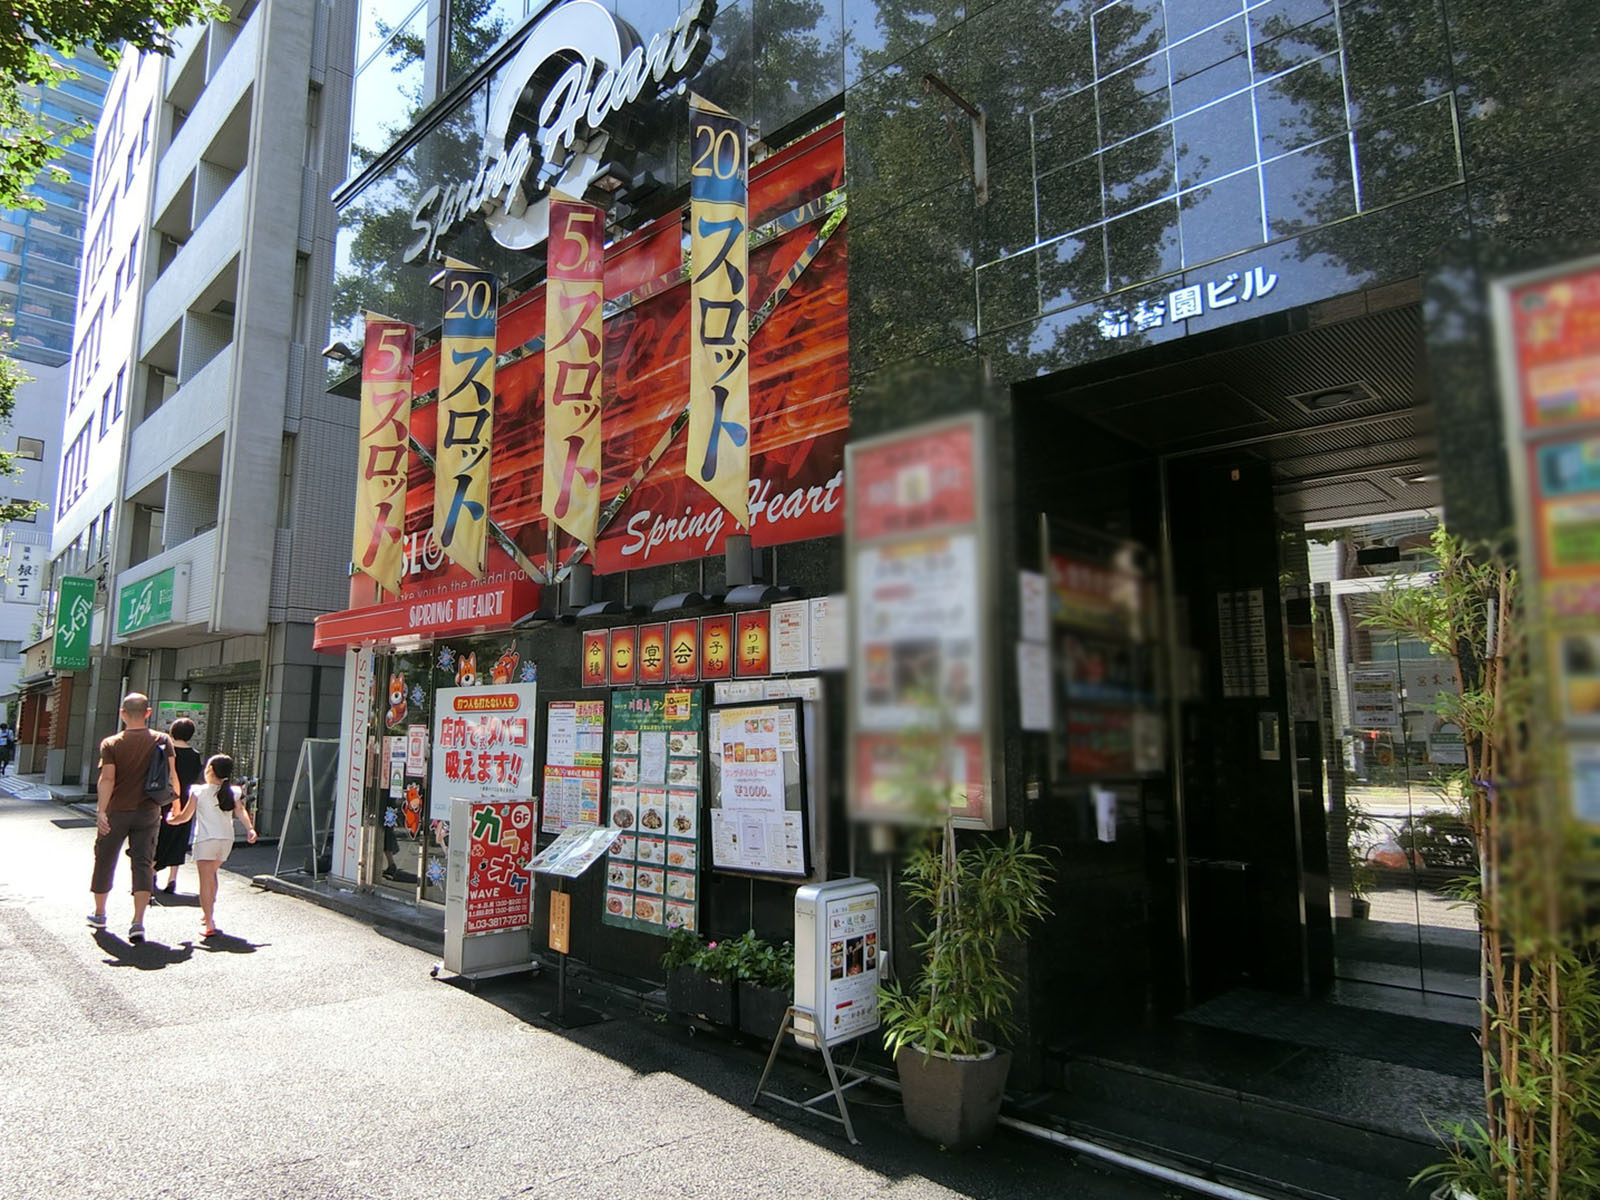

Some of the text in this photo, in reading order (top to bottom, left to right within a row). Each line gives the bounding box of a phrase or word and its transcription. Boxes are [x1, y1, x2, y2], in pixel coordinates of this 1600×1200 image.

[403, 0, 704, 263] Spring Heart
[693, 216, 747, 482] スロット
[441, 346, 494, 548] スロット
[548, 291, 601, 519] スロット
[361, 389, 410, 568] スロット
[621, 506, 725, 560] Spring
[58, 594, 93, 649] エイブル
[409, 590, 505, 628] SPRING HEART
[451, 580, 468, 590] the
[346, 658, 368, 859] SPRING HEART
[472, 805, 529, 895] カラオケ
[514, 810, 530, 825] 6F
[470, 887, 500, 900] WAVE
